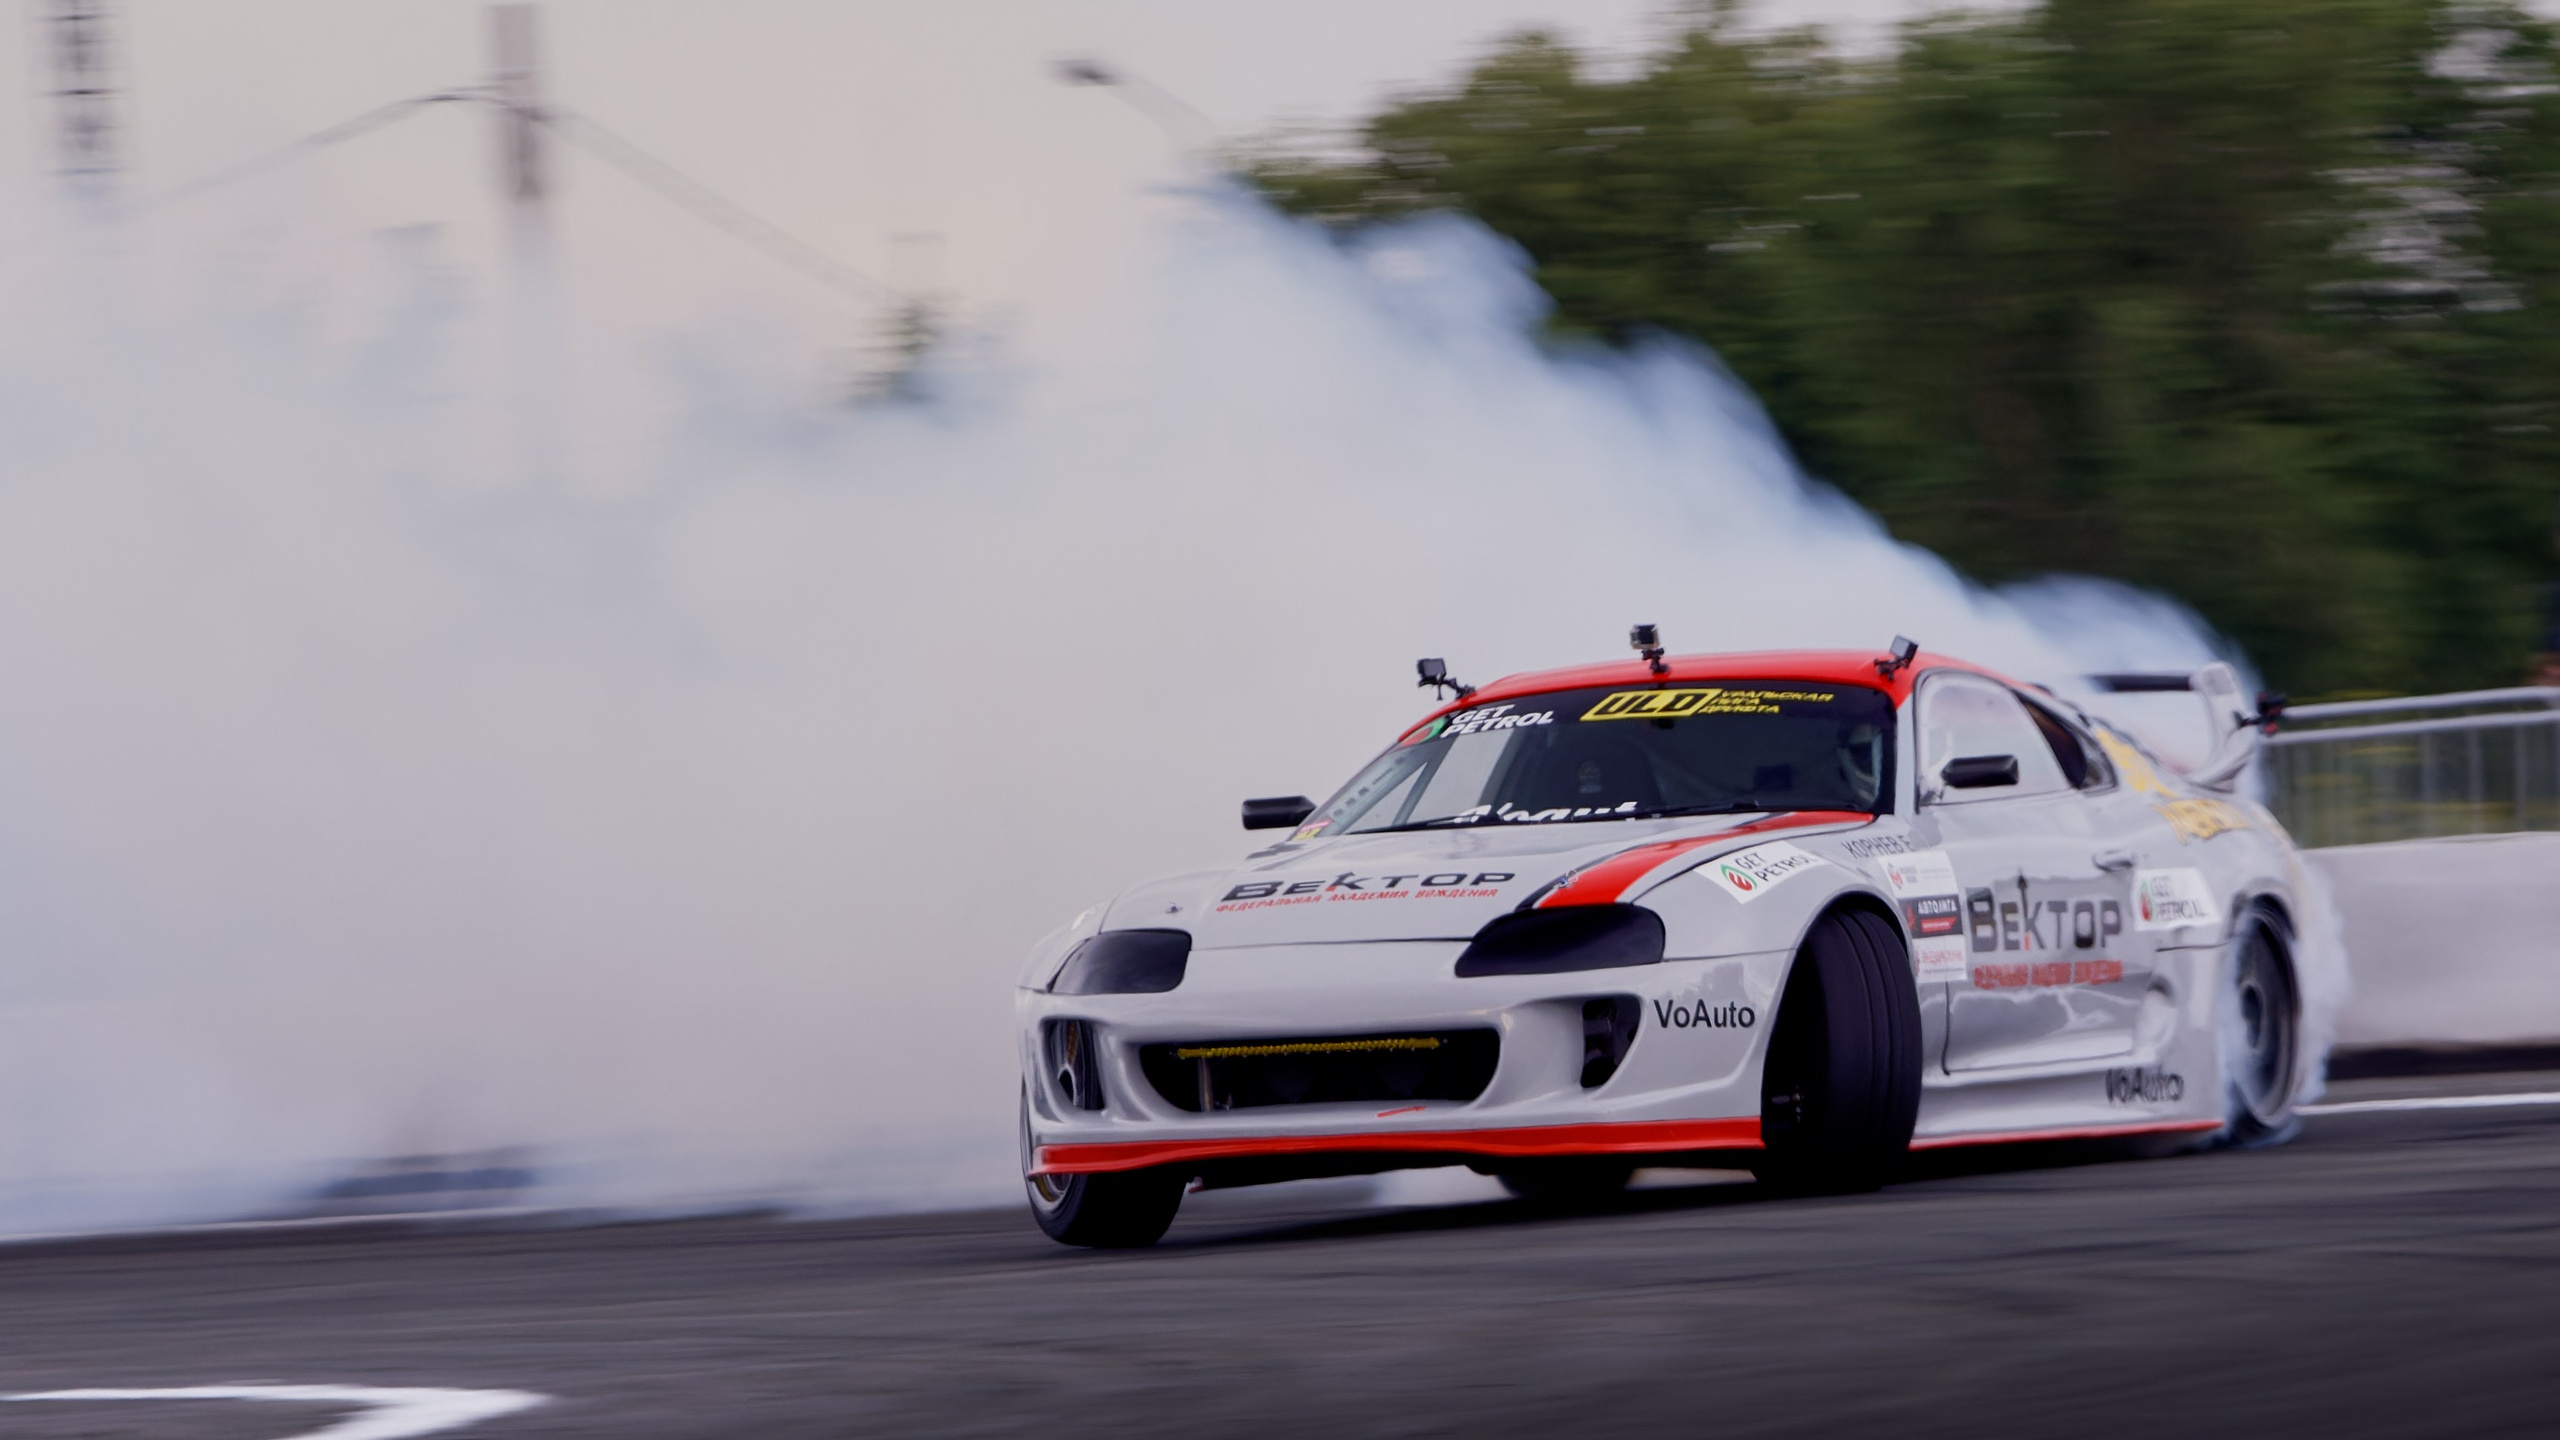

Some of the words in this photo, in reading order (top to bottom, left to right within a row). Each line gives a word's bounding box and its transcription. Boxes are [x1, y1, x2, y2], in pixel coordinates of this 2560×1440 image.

[1709, 696, 1760, 706] ЛИГА
[1439, 710, 1555, 738] PETROL
[1451, 703, 1516, 725] GET
[1734, 852, 1767, 870] GET
[1216, 894, 1323, 913] ФЕДЕРАЛЬНАЯ
[1327, 889, 1409, 903] АКАДЕМИЯ
[1414, 888, 1499, 900] ВОЖДЕНИЯ
[1652, 998, 1756, 1029] VoAuto
